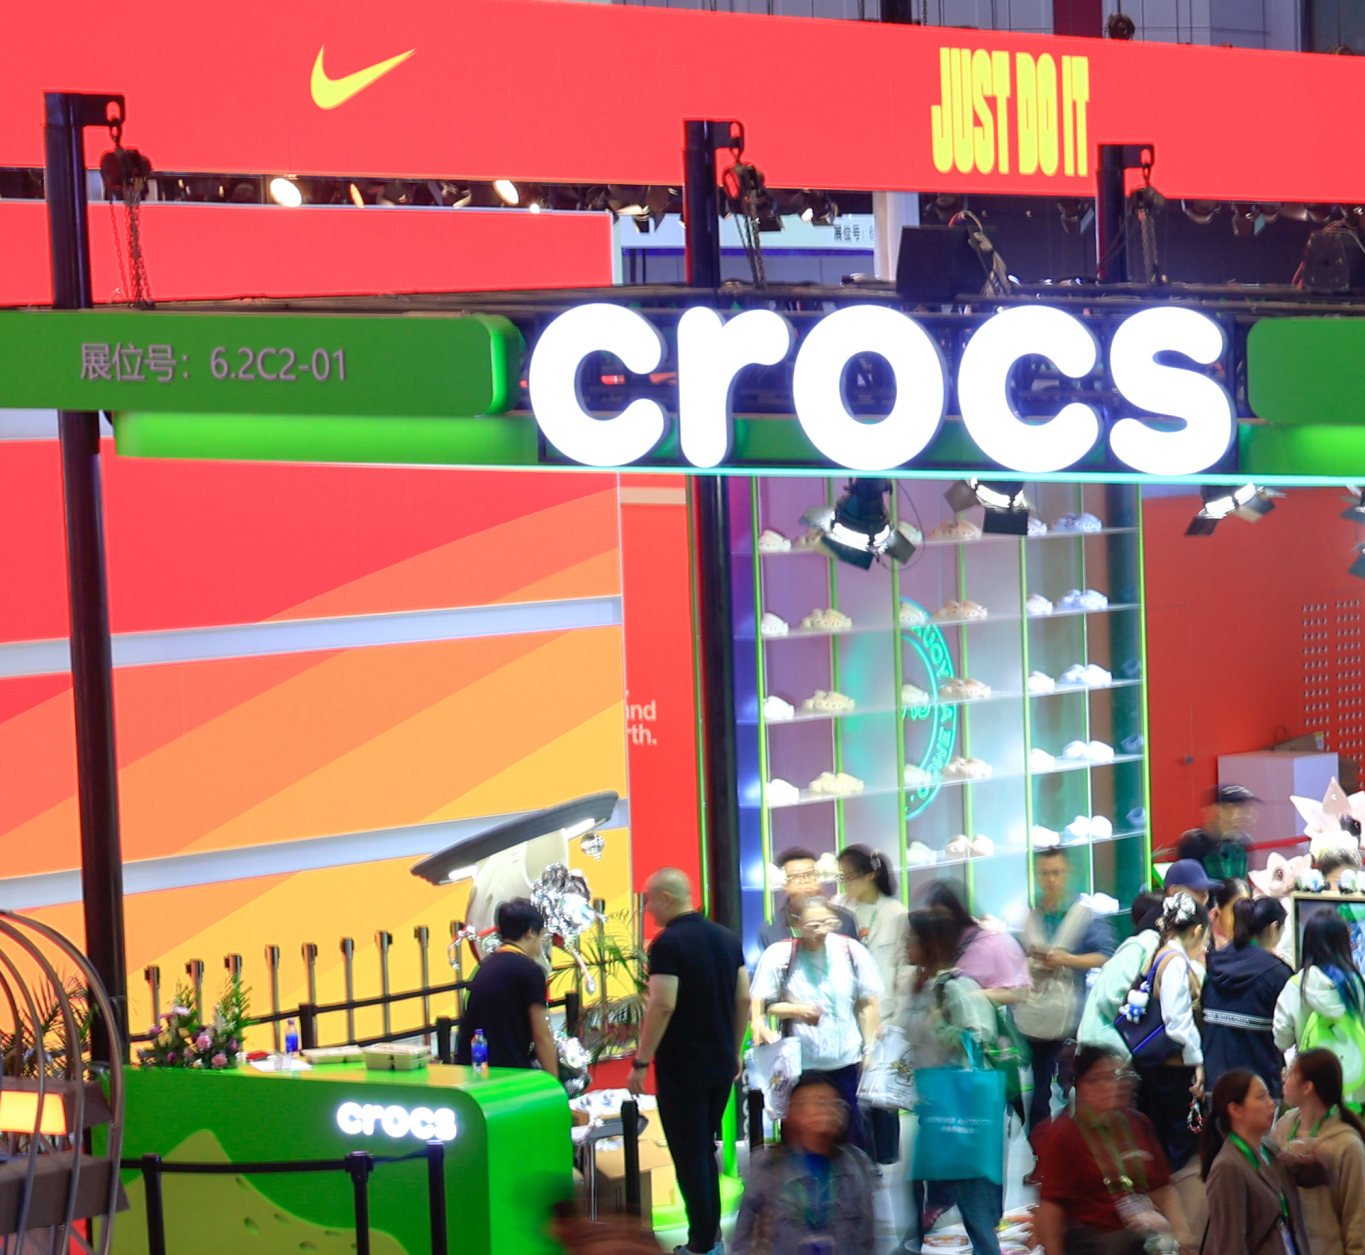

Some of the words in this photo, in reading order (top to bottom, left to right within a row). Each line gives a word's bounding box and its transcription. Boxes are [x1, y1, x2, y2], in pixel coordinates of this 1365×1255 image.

[931, 47, 1010, 174] JUST
[1016, 52, 1058, 176] DO
[1062, 55, 1089, 177] IT
[80, 343, 189, 384] 展位号：
[210, 346, 346, 381] 6.2C2-01
[528, 302, 1238, 477] crocs
[336, 1101, 458, 1141] crocs
